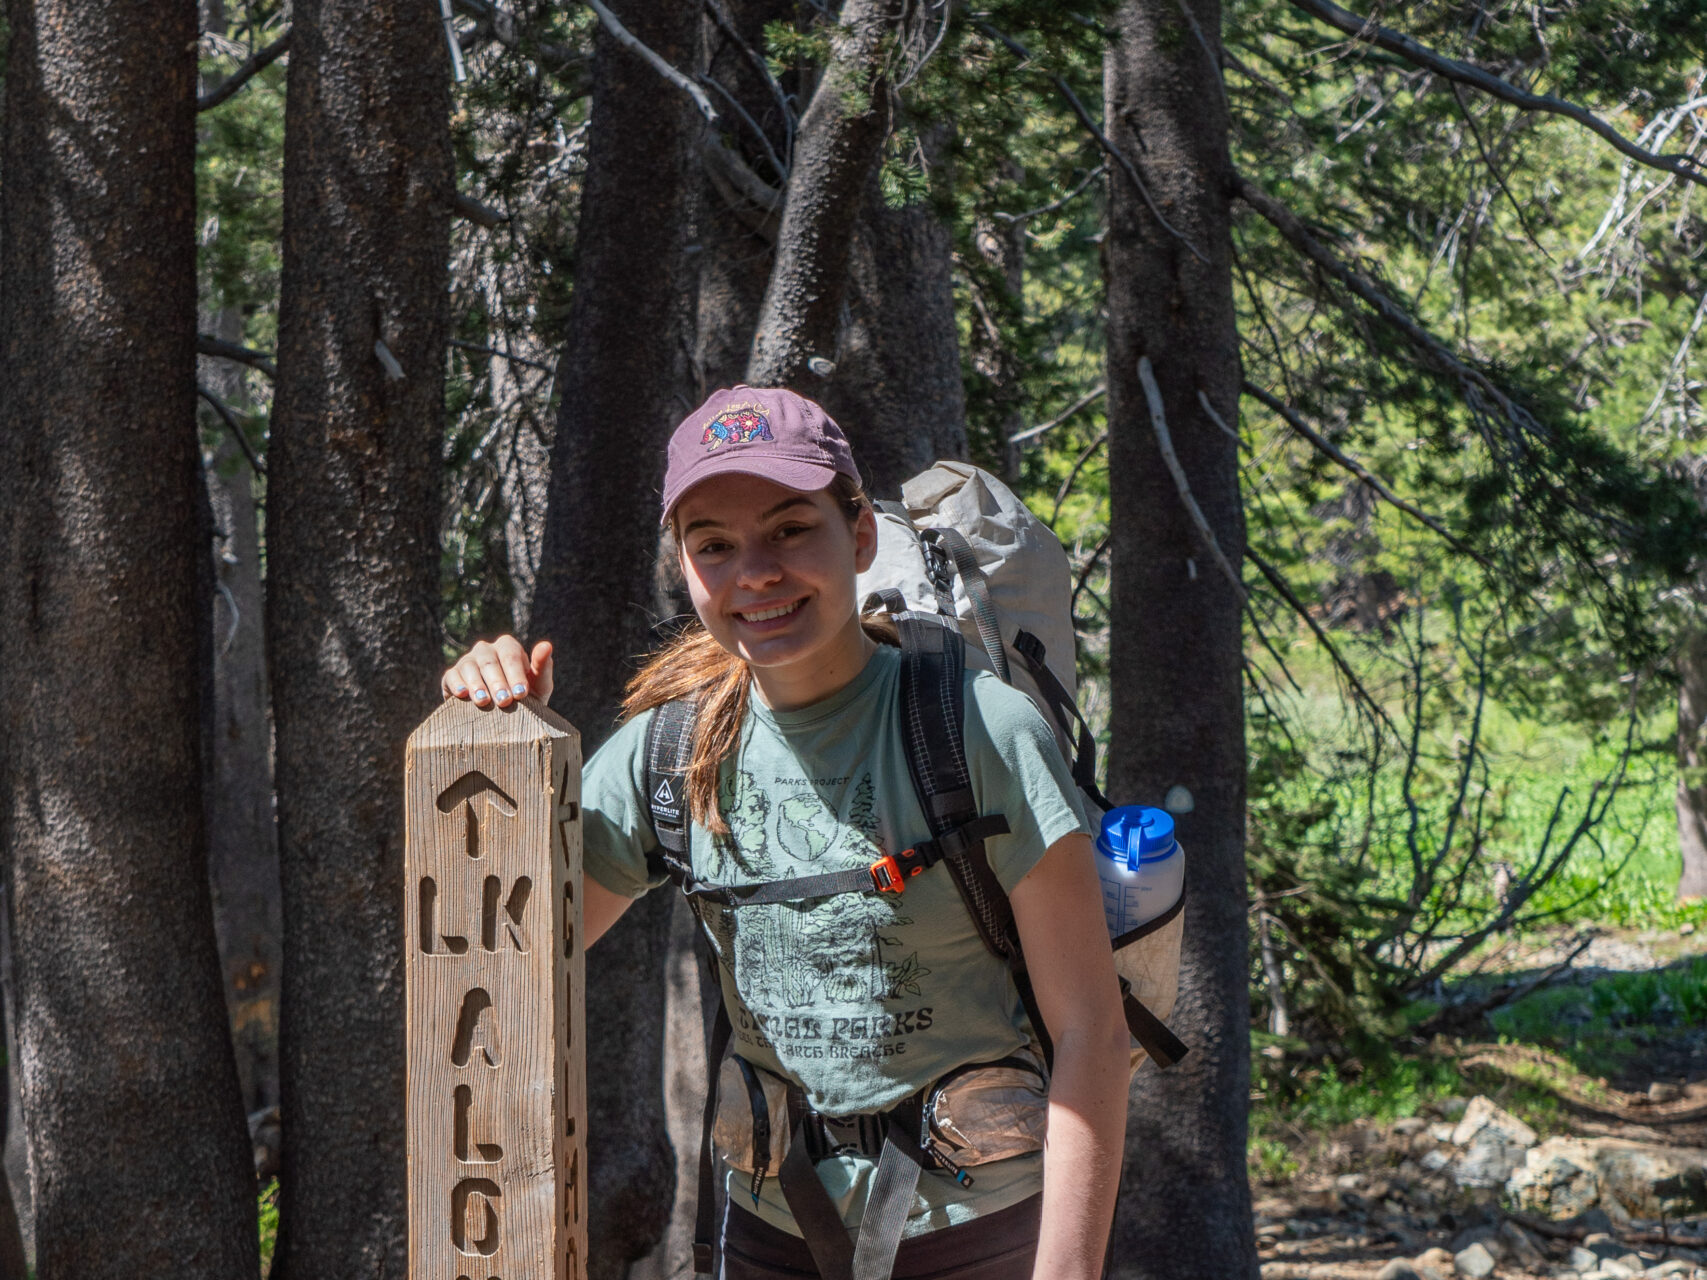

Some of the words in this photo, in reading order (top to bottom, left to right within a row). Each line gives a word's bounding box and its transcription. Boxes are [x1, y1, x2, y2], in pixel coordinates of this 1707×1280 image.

[775, 777, 807, 786] PARKS
[810, 776, 850, 786] PROJECT
[419, 874, 532, 956] LK
[831, 1007, 934, 1041] PARKS
[781, 1043, 824, 1059] EARTH
[829, 1041, 907, 1059] BREATHE
